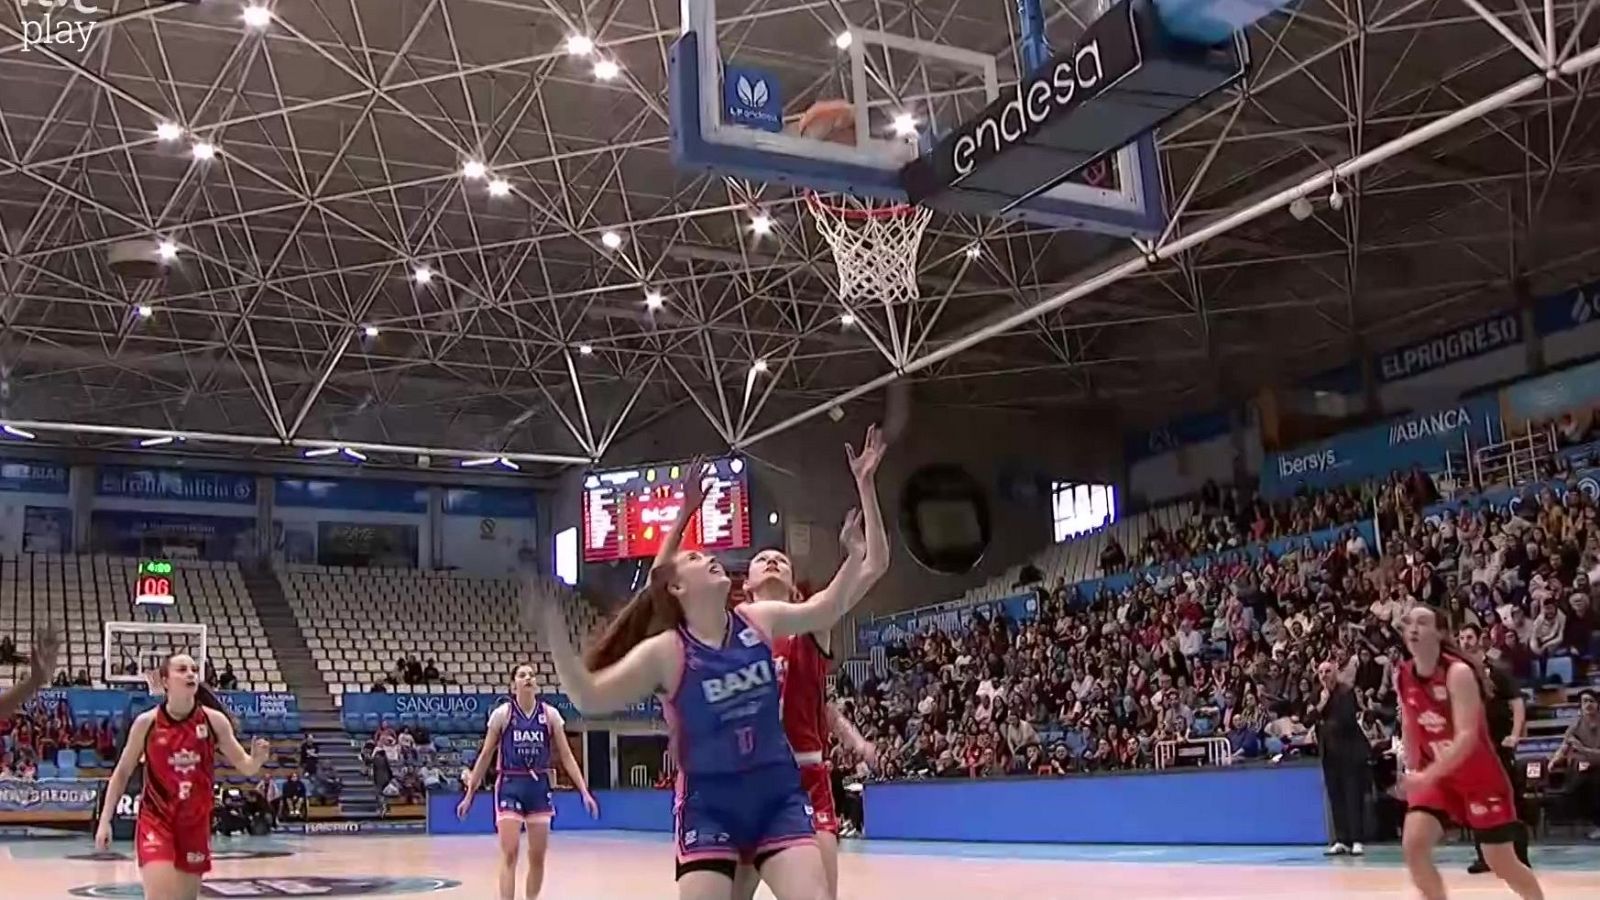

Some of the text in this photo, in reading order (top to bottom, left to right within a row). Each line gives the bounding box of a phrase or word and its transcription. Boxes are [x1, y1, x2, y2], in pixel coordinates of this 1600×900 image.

[953, 39, 1103, 174] endesa
[702, 659, 772, 703] BAXI
[396, 696, 477, 713] SANGUIAO
[513, 730, 544, 742] BAXI
